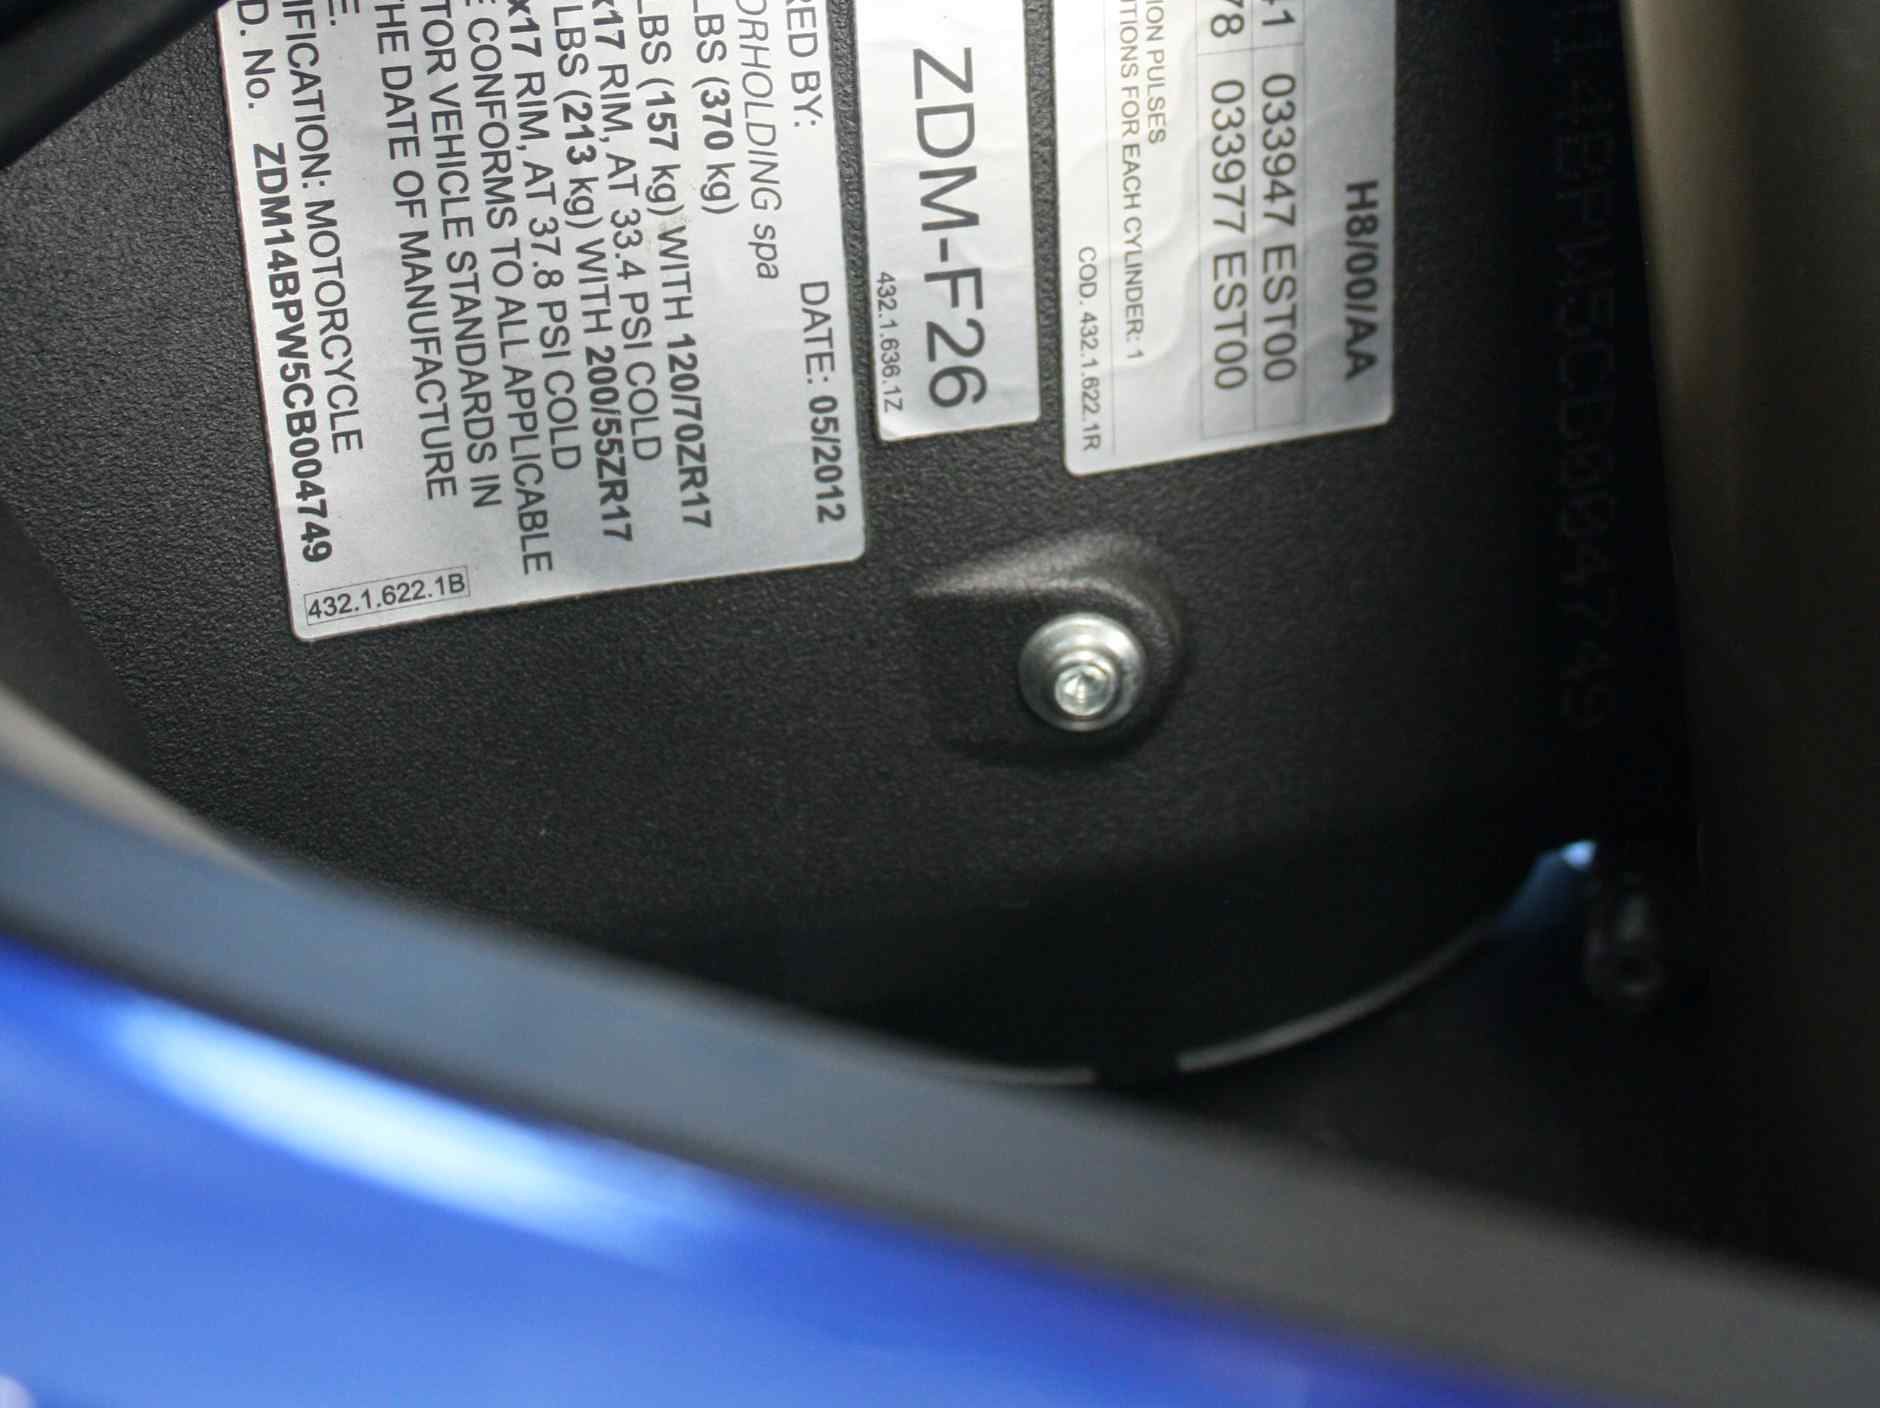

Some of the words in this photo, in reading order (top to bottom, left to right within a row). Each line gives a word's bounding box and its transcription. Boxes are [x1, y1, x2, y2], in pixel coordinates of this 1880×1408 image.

[242, 50, 275, 109] No.
[554, 5, 588, 76] LBS
[382, 66, 419, 159] DATE
[468, 18, 517, 229] CONFORMS
[515, 72, 549, 151] RIM,
[554, 90, 595, 164] (213
[598, 64, 632, 143] RIM,
[637, 78, 679, 150] (157
[692, 76, 733, 150] (370
[792, 71, 823, 127] BY:
[1120, 86, 1139, 139] FOR
[1147, 49, 1166, 143] PULSES
[430, 84, 473, 239] VEHICLE
[523, 161, 556, 207] AT
[606, 152, 638, 195] AT
[701, 163, 739, 215] kg)
[1121, 144, 1142, 210] EACH
[1212, 79, 1246, 235] 033977
[1262, 73, 1296, 226] 033947
[394, 170, 426, 218] OF
[564, 177, 602, 229] kg)
[646, 164, 685, 216] kg)
[913, 47, 987, 409] ZDM-F26
[490, 239, 521, 287] TO
[529, 217, 564, 288] 37.8
[611, 208, 645, 279] 33.4
[658, 226, 694, 321] WITH
[749, 224, 780, 279] spa
[1078, 247, 1097, 305] COD.
[1123, 217, 1144, 343] CYLINDER:
[1345, 182, 1379, 381] H8/00/AA
[575, 239, 612, 333] WITH
[619, 292, 651, 349] PSI
[1214, 253, 1248, 390] EST00
[1263, 244, 1297, 383] EST00
[254, 143, 333, 562] ZDM14BPW5CB004749
[305, 200, 363, 454] MOTORCYCLE
[398, 231, 456, 500] MANUFACTURE
[446, 250, 497, 464] STANDARDS
[496, 296, 529, 358] ALL
[537, 301, 570, 358] PSI
[801, 281, 833, 384] DATE:
[877, 272, 902, 412] 432.1.636.1Z
[1126, 349, 1143, 359] 1
[544, 370, 582, 470] COLD
[625, 361, 662, 461] COLD
[1079, 312, 1100, 451] 432.1.622.1R
[502, 365, 553, 575] APPLICABLE
[585, 346, 632, 542] 200/55ZR17
[667, 333, 712, 528] 120/70ZR17
[809, 396, 845, 523] 05/2012
[471, 475, 502, 508] IN
[307, 573, 466, 617] 432.1.622.1B
